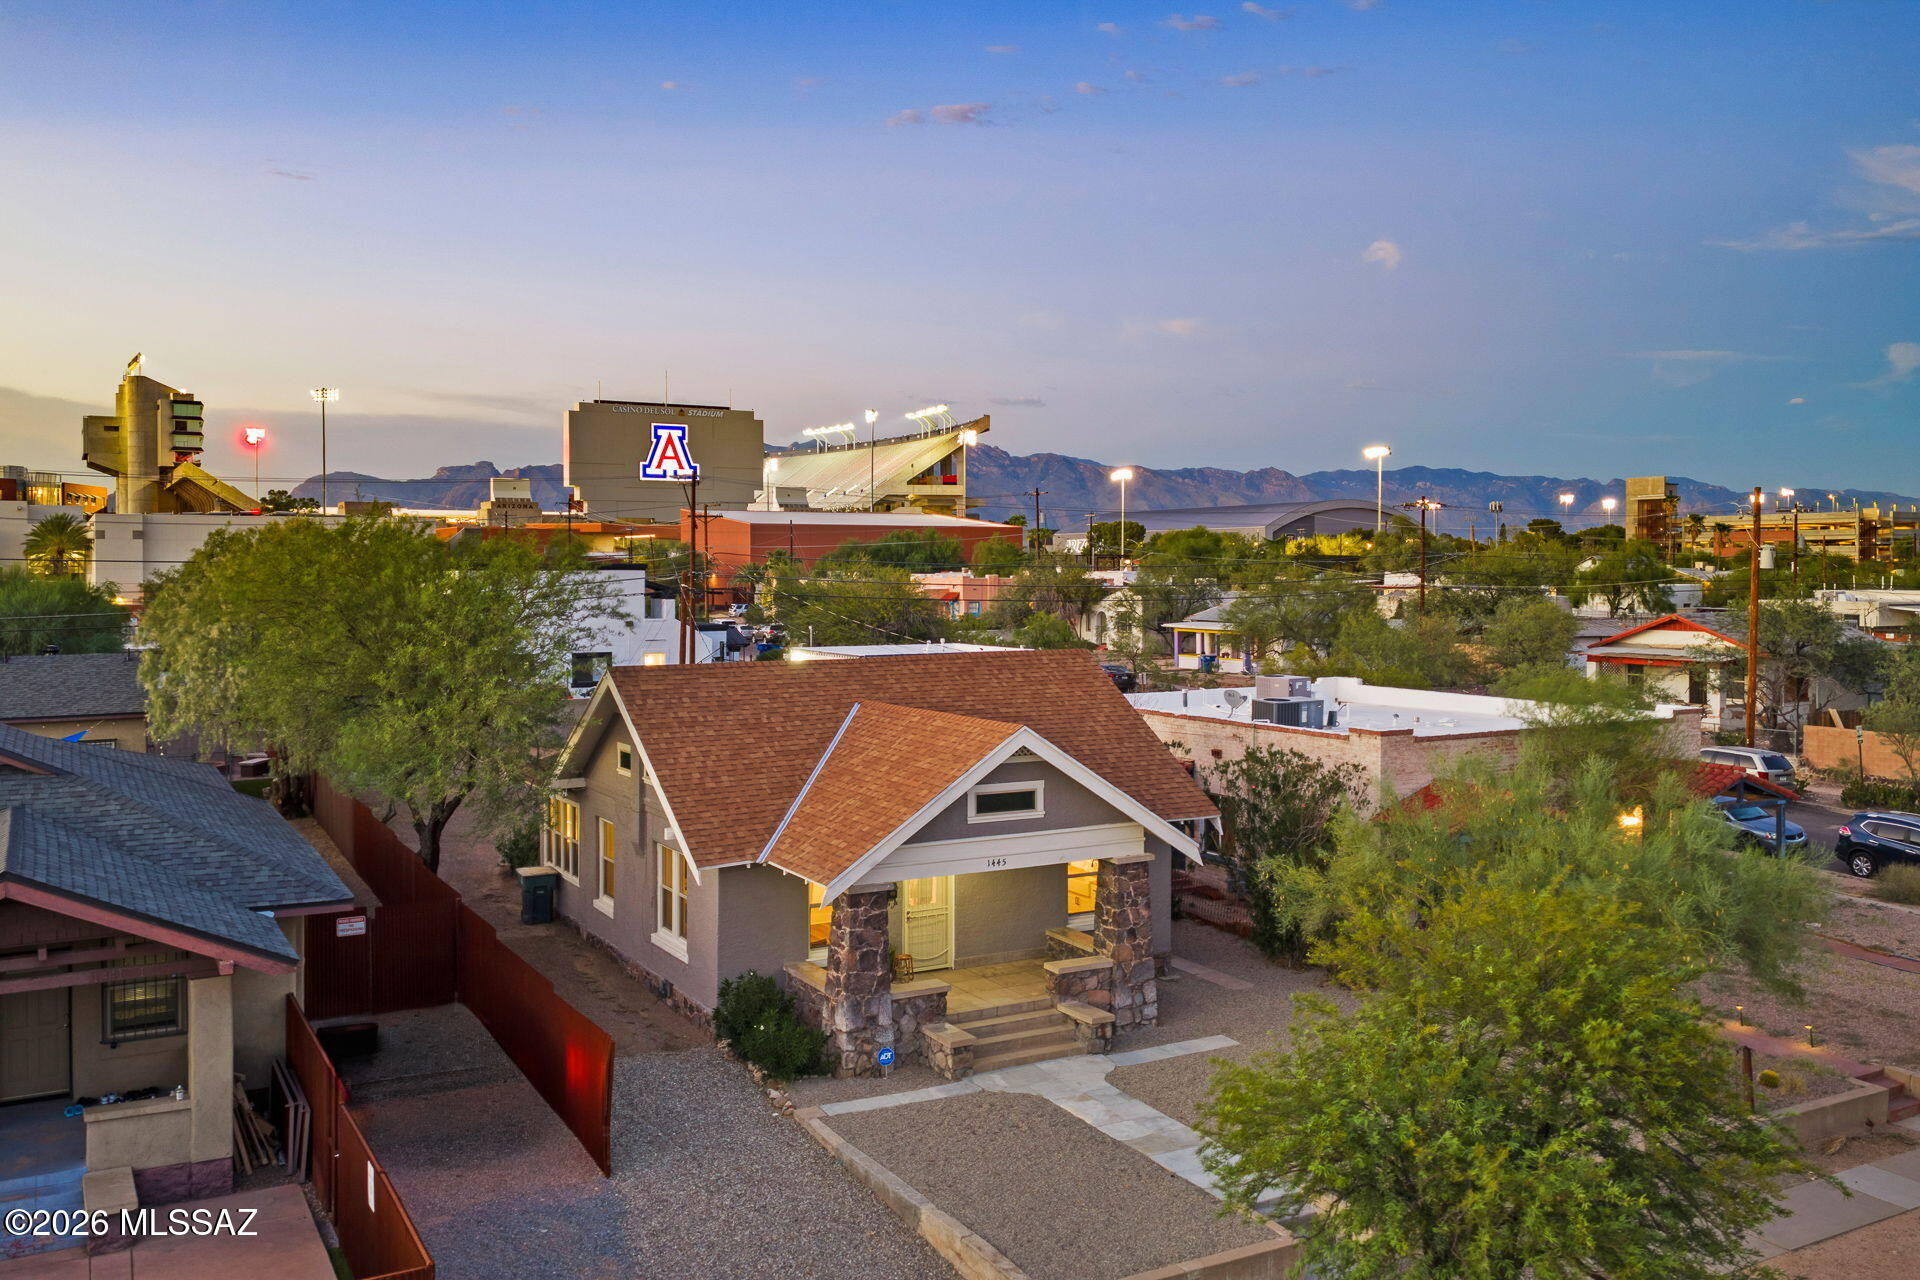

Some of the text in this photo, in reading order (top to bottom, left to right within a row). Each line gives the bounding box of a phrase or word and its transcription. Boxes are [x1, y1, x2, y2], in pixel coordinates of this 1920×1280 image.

[687, 409, 724, 417] STADIUM
[640, 423, 699, 481] A
[987, 858, 1007, 867] 1445
